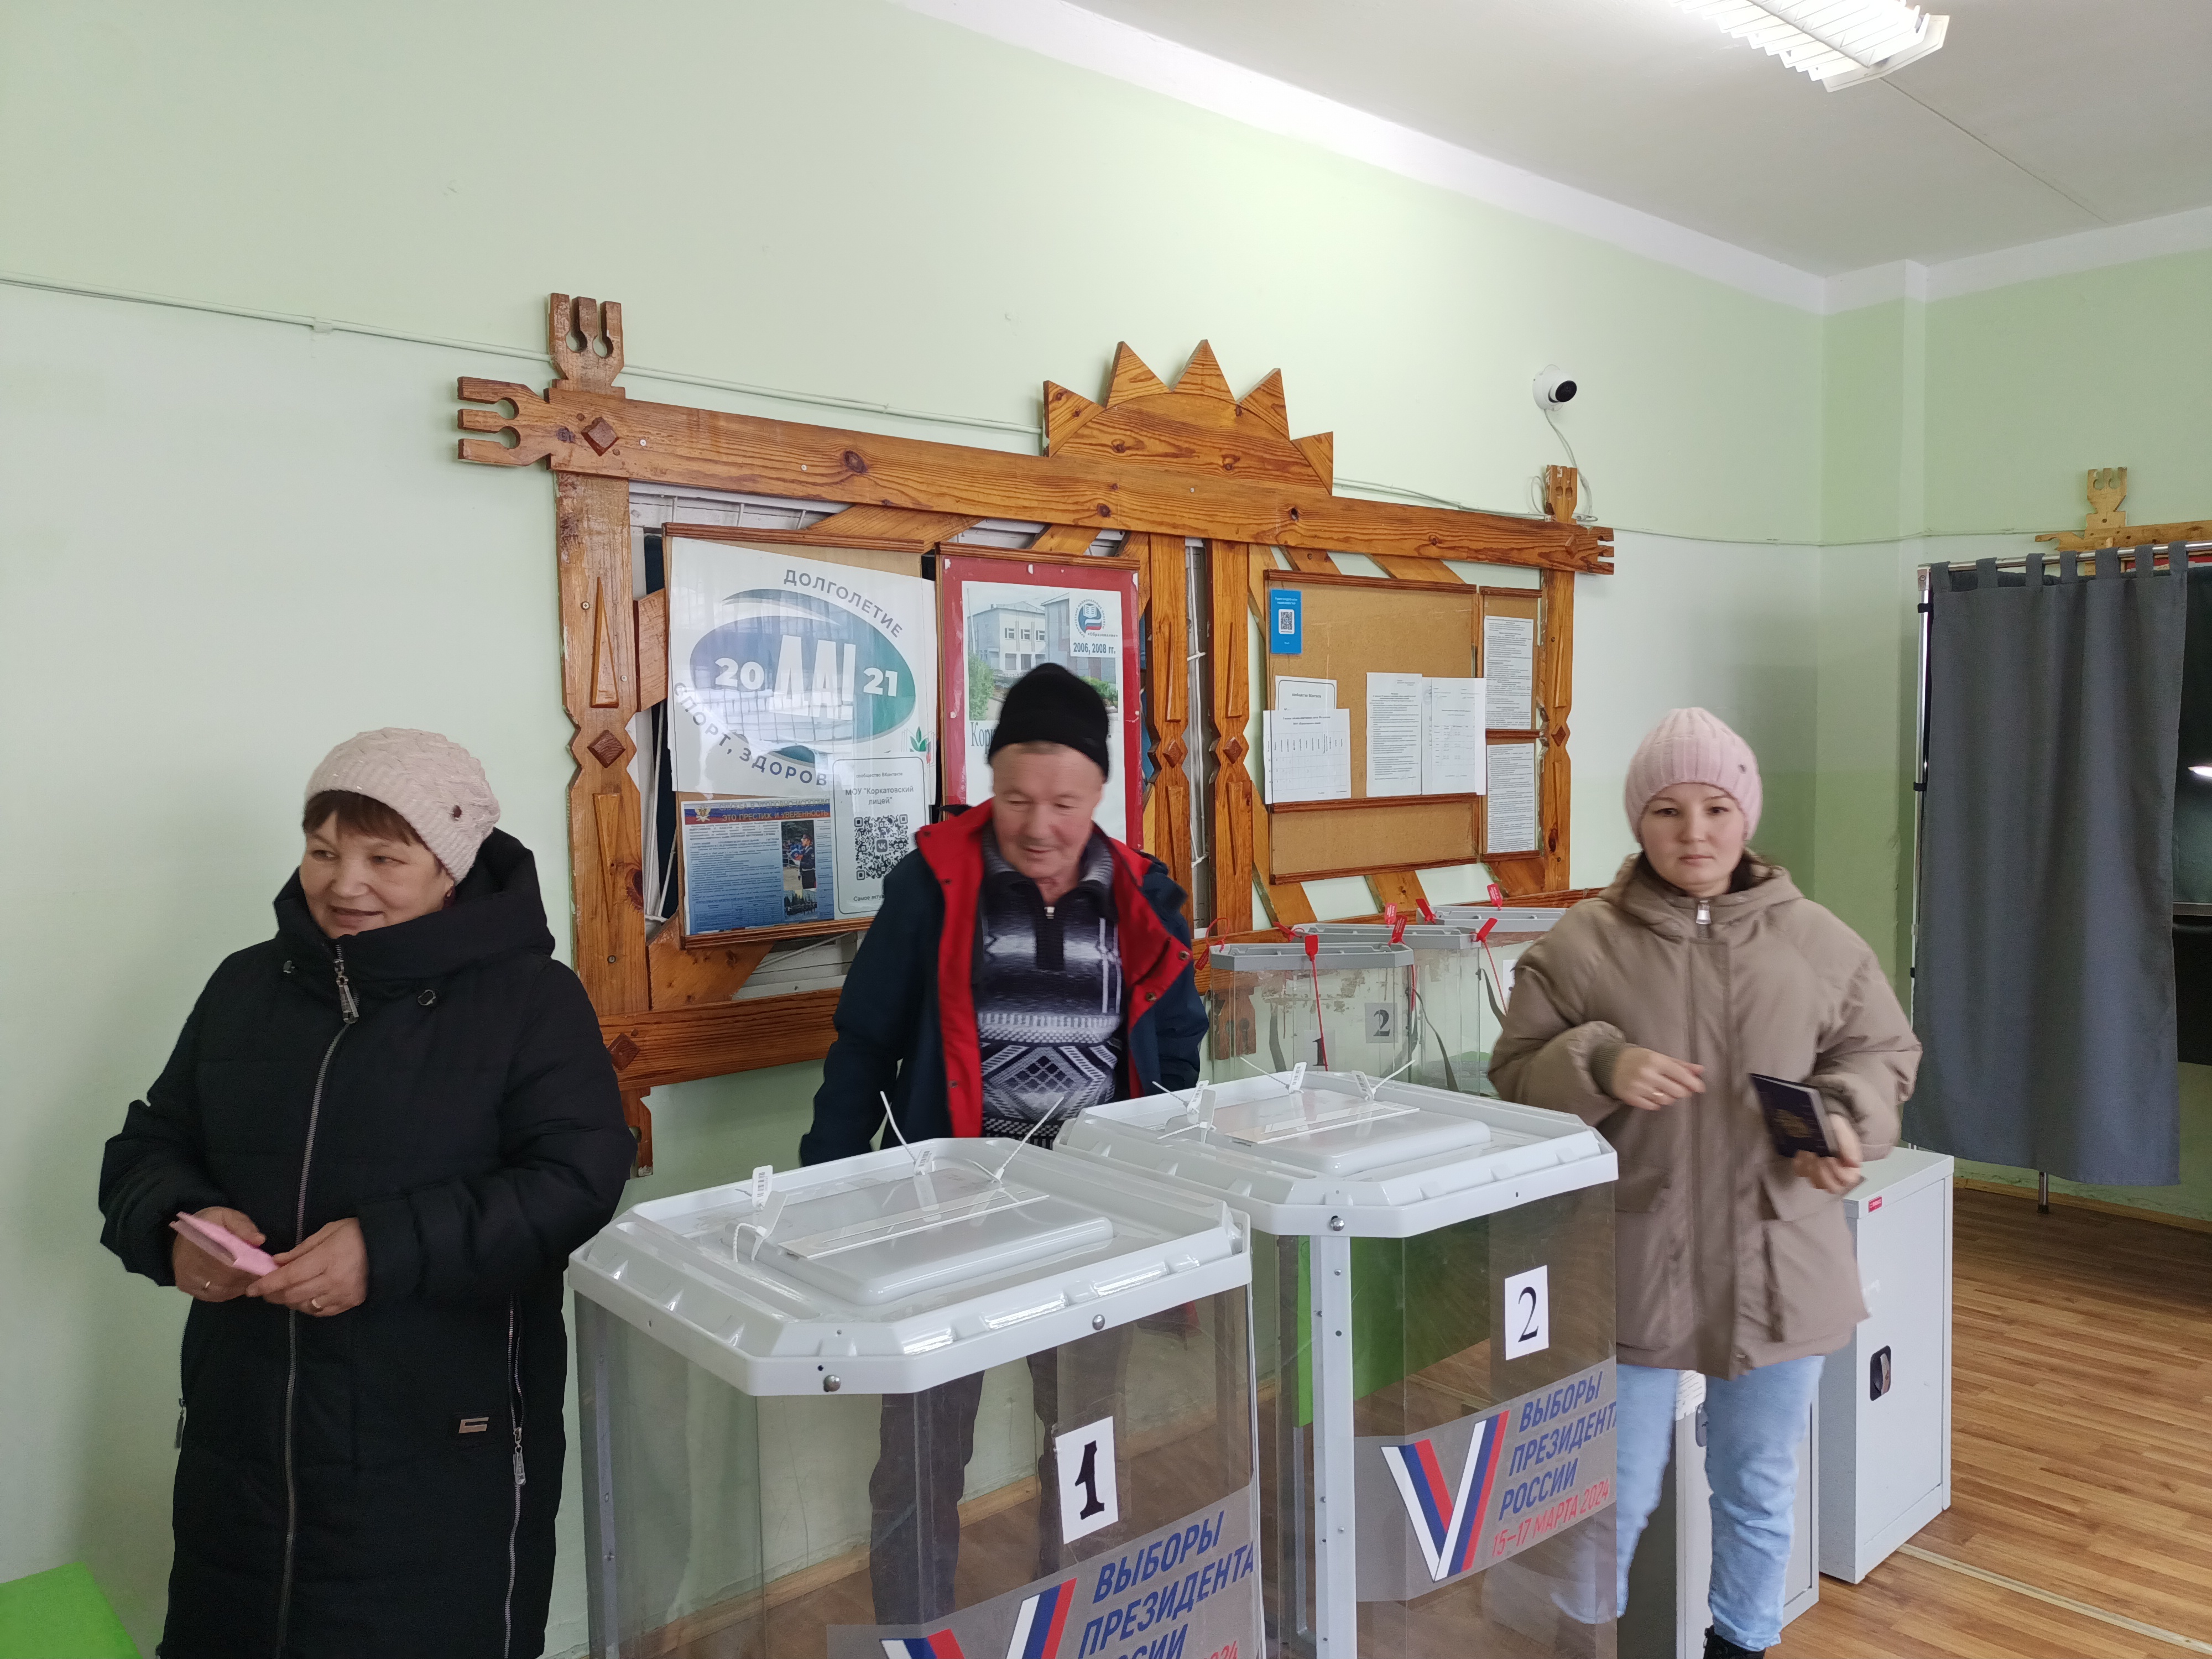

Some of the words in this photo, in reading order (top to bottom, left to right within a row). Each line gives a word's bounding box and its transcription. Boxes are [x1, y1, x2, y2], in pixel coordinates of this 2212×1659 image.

[784, 569, 903, 638] ДОЛГОЛЕТИЕ
[1073, 642, 1091, 655] 2006,
[1092, 643, 1107, 654] 2008
[714, 658, 765, 690] 20
[863, 667, 898, 697] 21
[739, 812, 772, 821] ПРЕСТИЖ
[781, 810, 829, 818] УВЕРЕННОСТЬ
[845, 787, 862, 796] МОУ
[864, 785, 914, 796] "Коркатовский
[868, 797, 893, 805] лицей"
[1312, 1037, 1328, 1066] 1
[1373, 1009, 1391, 1037] 2
[1517, 1286, 1539, 1343] 2
[1519, 1371, 1603, 1433] ВЫБОРЫ
[1074, 1440, 1105, 1520] 1
[1499, 1458, 1579, 1521] РОССИИ
[1532, 1494, 1578, 1539] МАРТА
[1580, 1478, 1610, 1514] 2024
[1092, 1510, 1224, 1604] ВЫБОРЫ
[1078, 1541, 1254, 1659] ПРЕЗИДЕНТА
